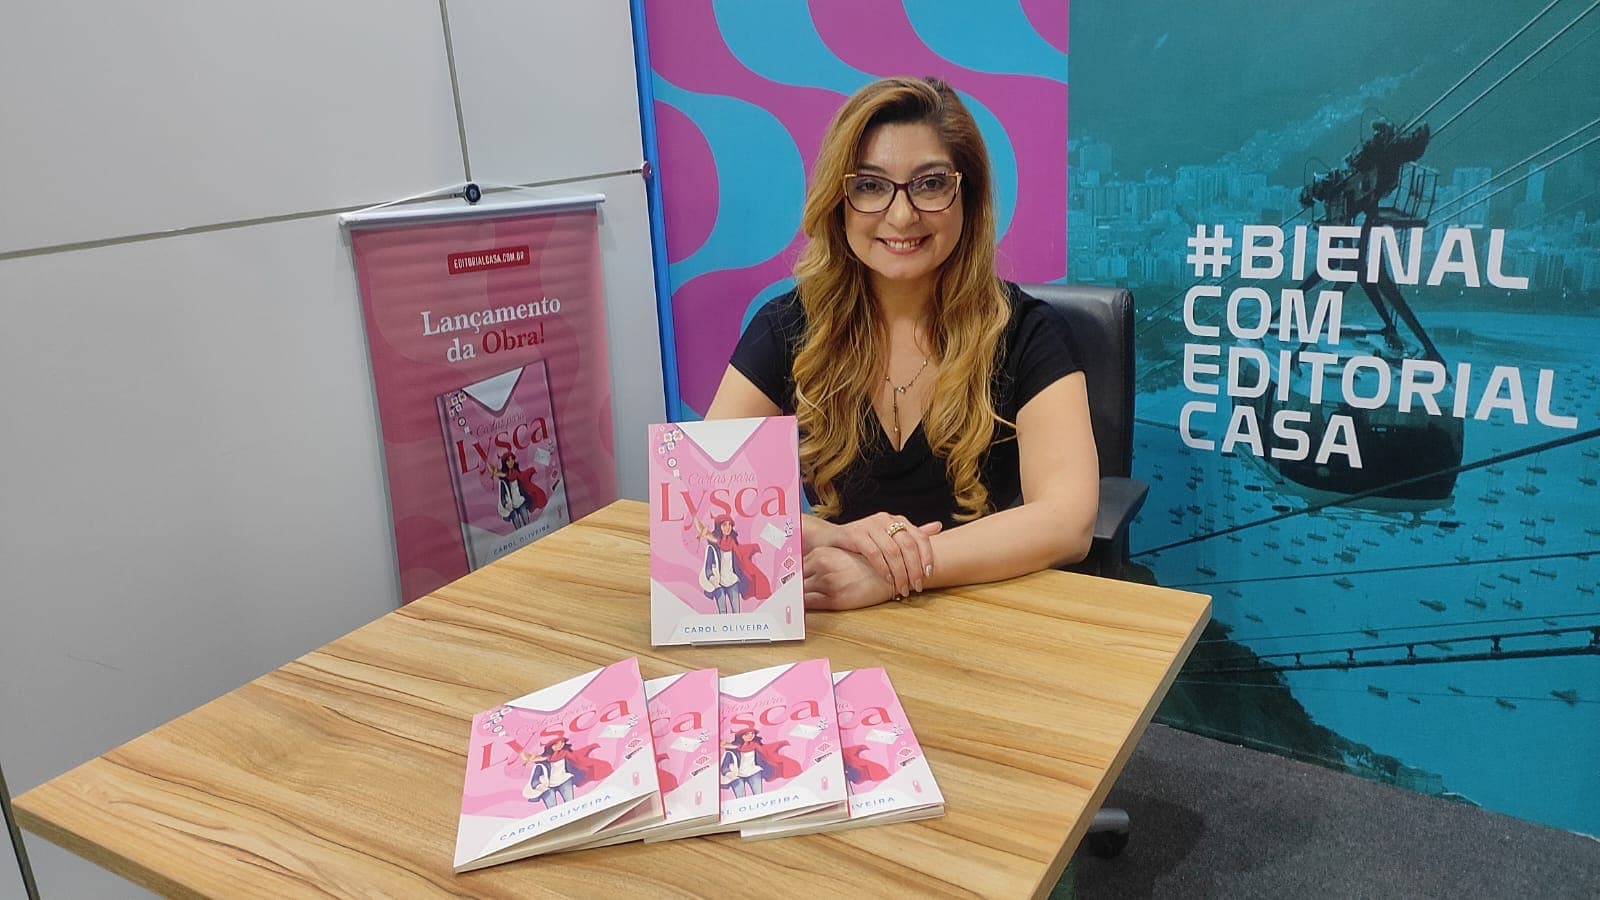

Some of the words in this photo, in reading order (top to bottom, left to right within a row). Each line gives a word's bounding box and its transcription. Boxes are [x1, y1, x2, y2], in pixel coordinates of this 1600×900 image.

[454, 250, 524, 269] EDITORIALCASA.COM.BR
[1187, 224, 1529, 290] #BIENAL
[420, 297, 560, 336] Lançamento
[1183, 285, 1343, 345] COM
[446, 337, 476, 362] da
[482, 322, 545, 354] Obra!
[1183, 343, 1578, 429] EDITORIAL
[456, 417, 548, 475] Lysca
[1179, 401, 1362, 469] CASA
[660, 482, 787, 531] Lysca
[684, 626, 718, 634] CAROL
[722, 623, 769, 632] OLIVEIRA
[480, 700, 630, 771] Lysca
[500, 821, 542, 841] CAROL
[550, 795, 611, 821] OLIVEIRA
[739, 795, 800, 812] OLIVEIRA
